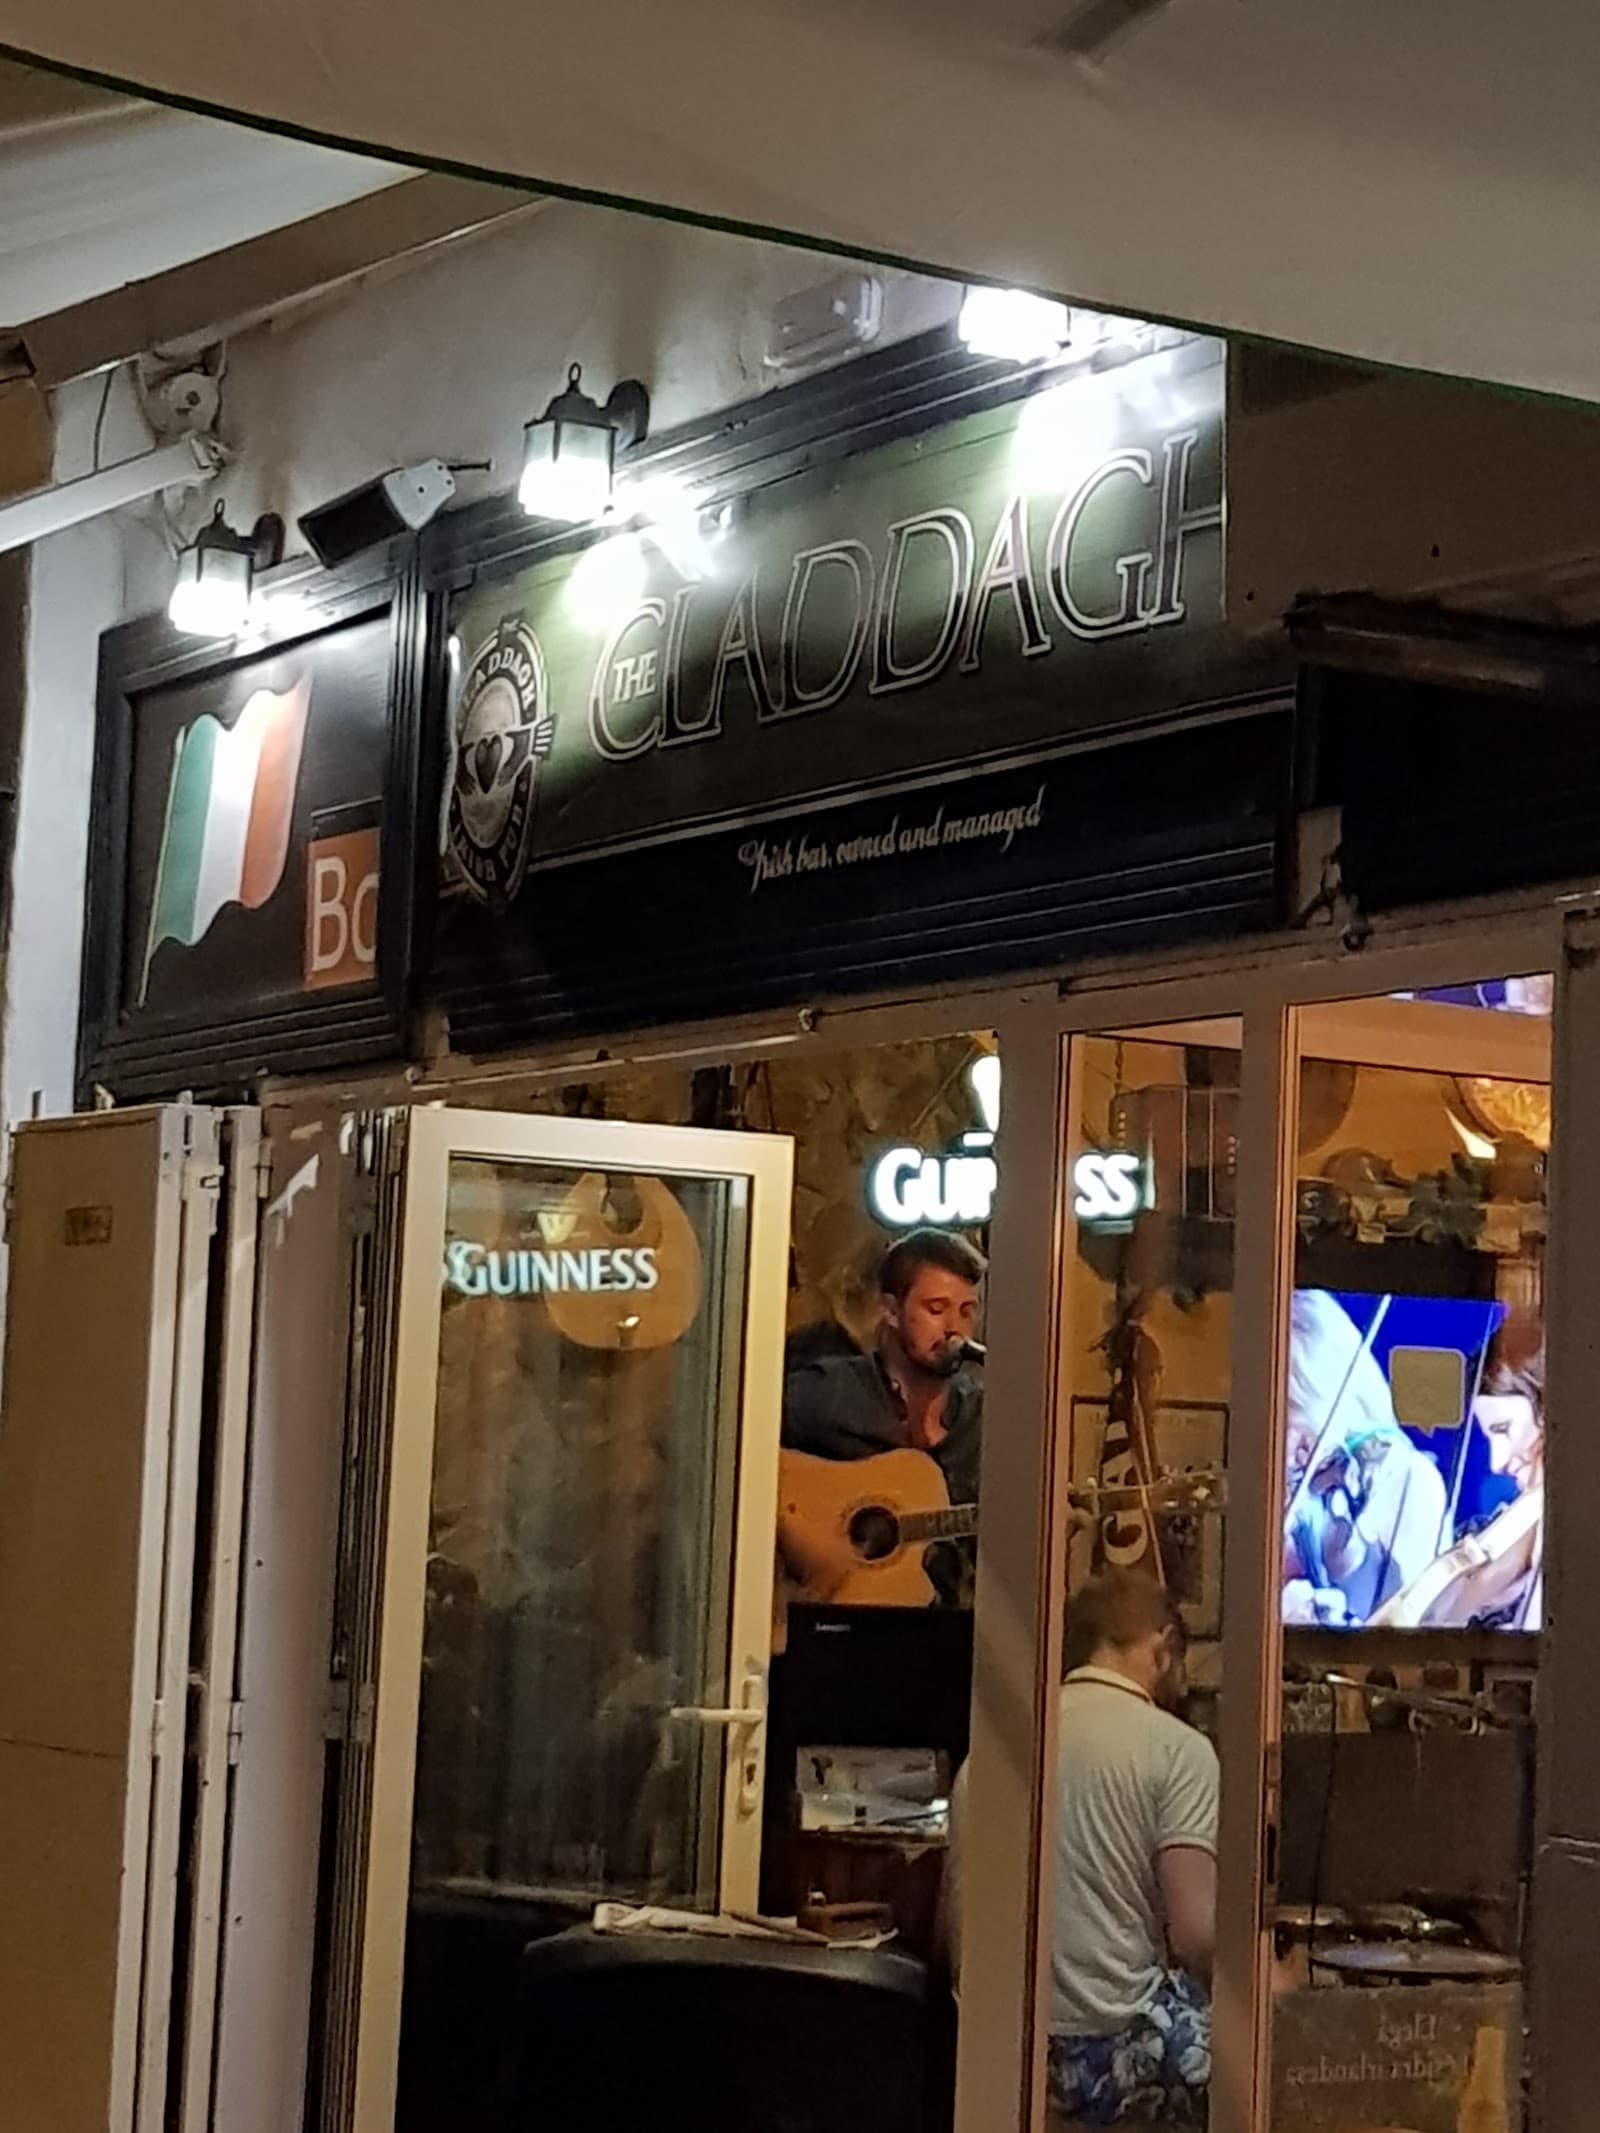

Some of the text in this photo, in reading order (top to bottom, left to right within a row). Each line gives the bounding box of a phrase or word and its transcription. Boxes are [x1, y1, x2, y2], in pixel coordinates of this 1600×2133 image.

[611, 649, 658, 704] THE
[898, 804, 946, 853] and
[942, 783, 1047, 855] managed
[448, 1240, 659, 1296] GUINNESS
